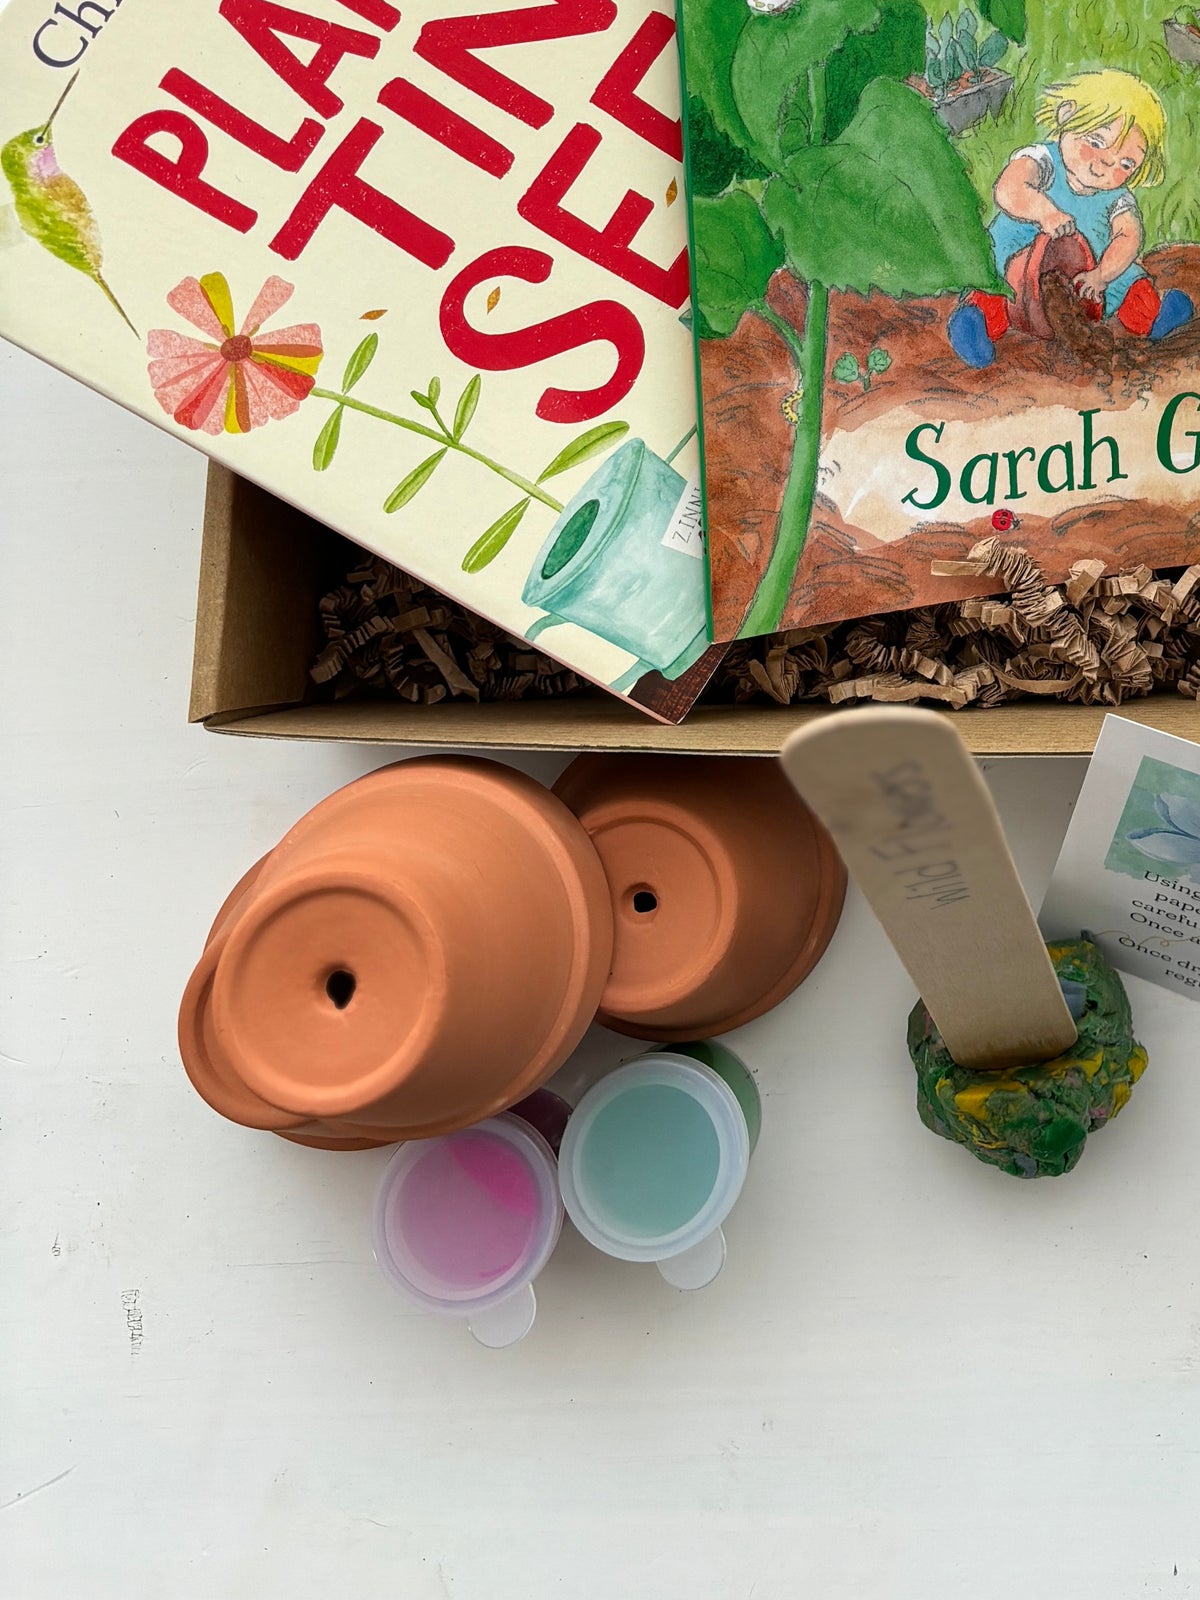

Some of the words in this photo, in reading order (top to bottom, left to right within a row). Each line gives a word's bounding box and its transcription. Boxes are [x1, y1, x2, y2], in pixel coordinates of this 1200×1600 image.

[901, 408, 1128, 509] Sarah
[1129, 911, 1184, 938] Once
[1117, 936, 1172, 962] Once
